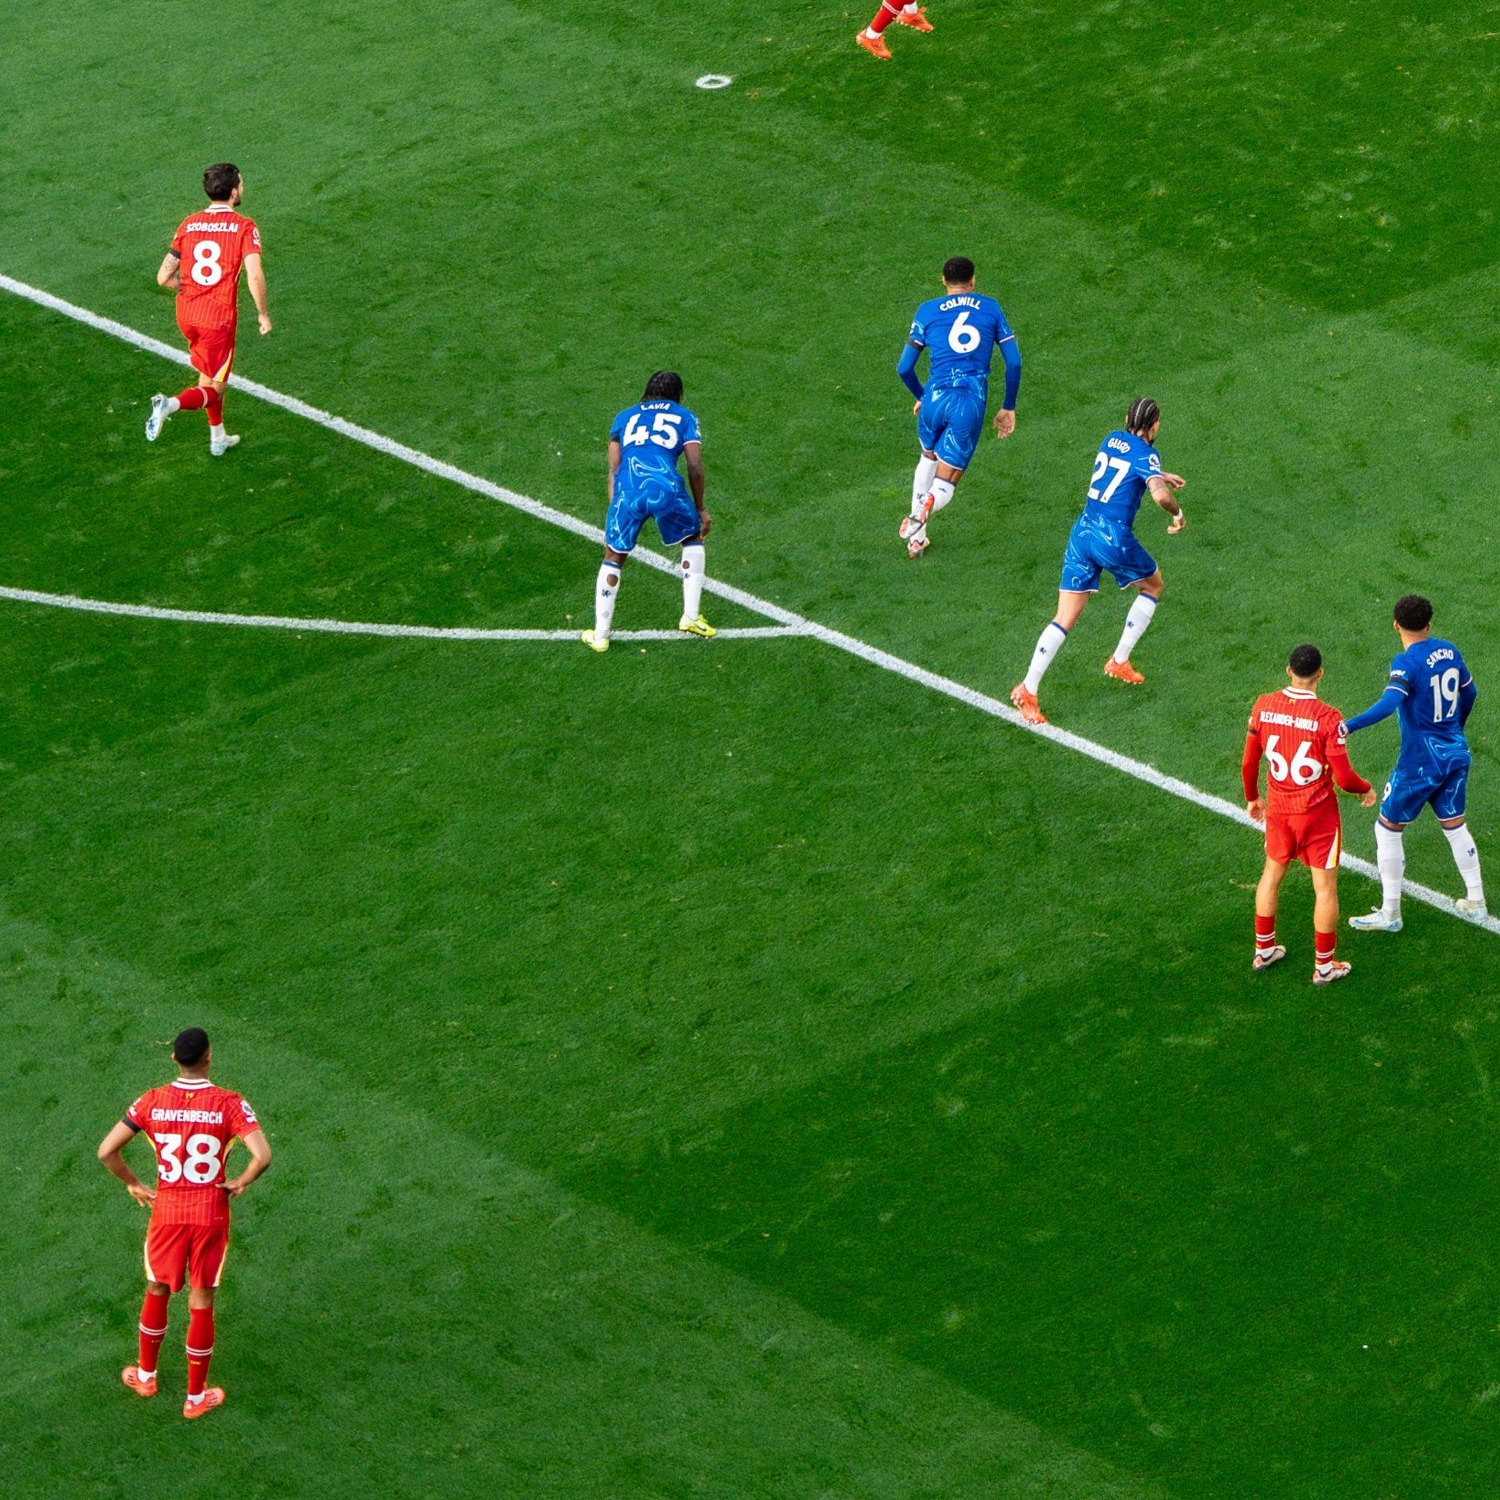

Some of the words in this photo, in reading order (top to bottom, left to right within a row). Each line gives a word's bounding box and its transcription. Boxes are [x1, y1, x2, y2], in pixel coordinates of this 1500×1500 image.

[186, 221, 239, 233] SZOBOSZLAI
[191, 240, 222, 286] 8
[939, 296, 982, 312] COLWILL
[948, 311, 981, 354] 6
[640, 402, 671, 411] LAVIA
[623, 412, 682, 450] 45
[1087, 451, 1132, 504] 27
[1430, 667, 1460, 724] 19
[1259, 710, 1319, 733] ALEXANDER-ARNOLD
[1265, 734, 1323, 786] 66
[151, 1107, 223, 1125] GRAVENBERCH
[153, 1132, 222, 1184] 38
